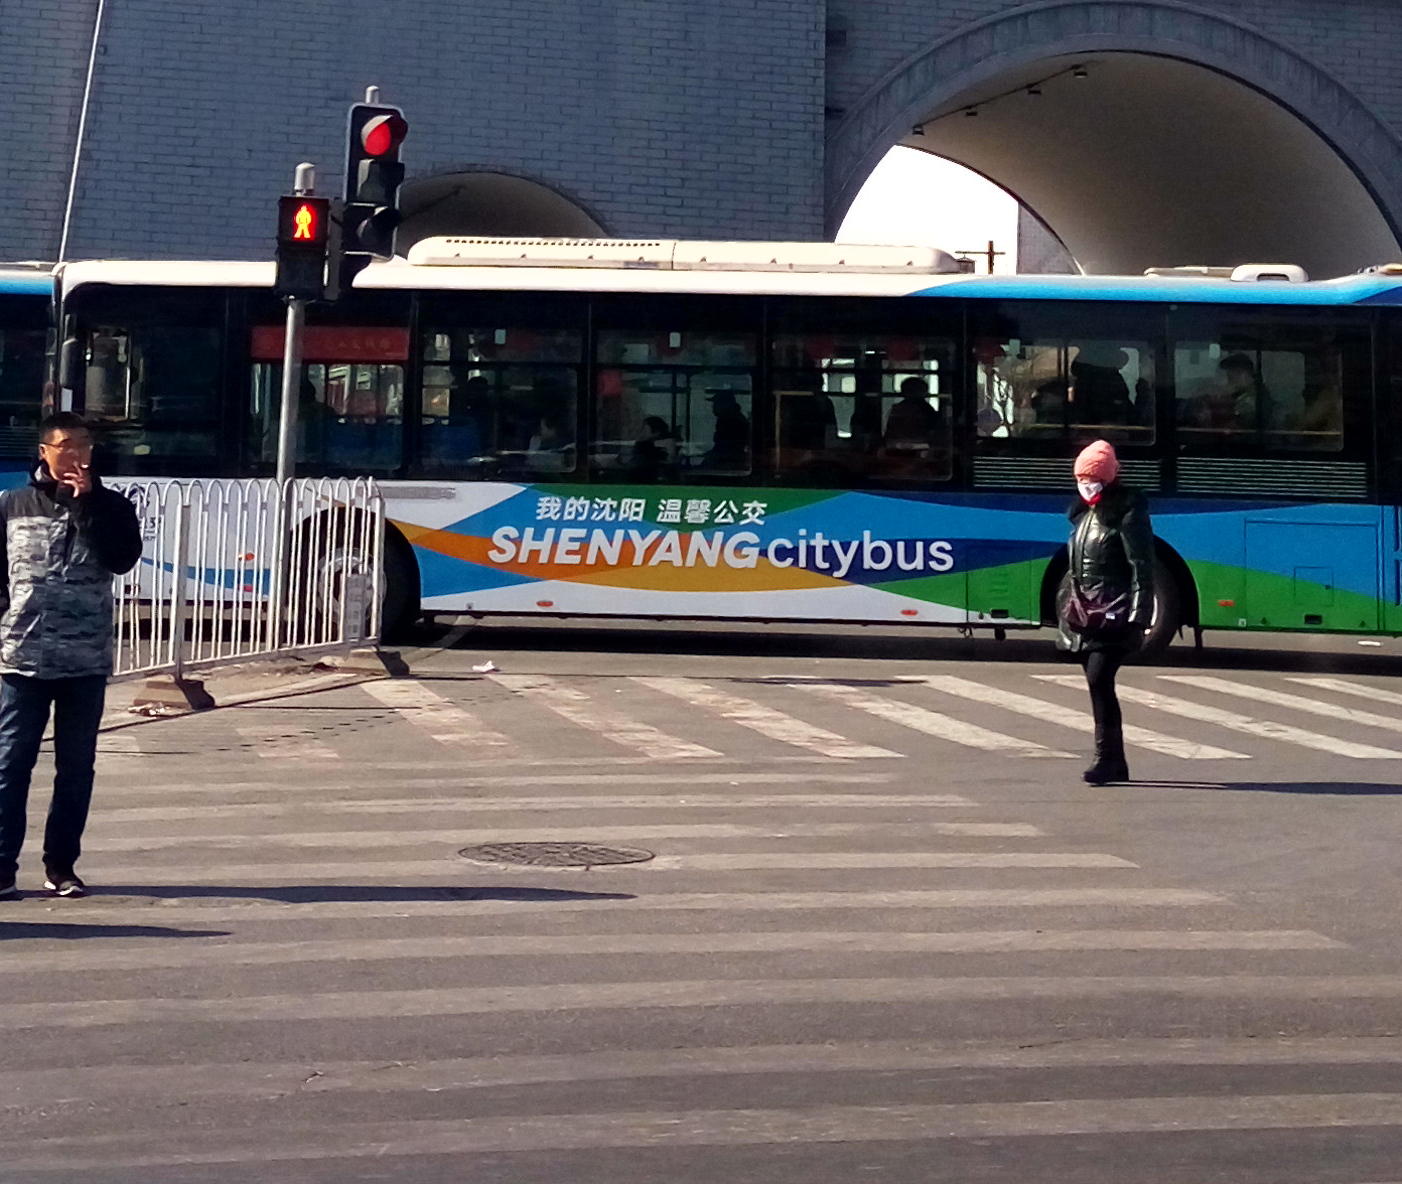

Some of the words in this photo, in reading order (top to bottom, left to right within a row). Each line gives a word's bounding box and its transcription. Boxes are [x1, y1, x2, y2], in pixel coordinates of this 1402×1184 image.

[536, 496, 646, 522] 我的沈阳
[657, 498, 768, 526] 温馨公交
[487, 526, 760, 569] SHENYANG
[767, 528, 954, 578] citybus
